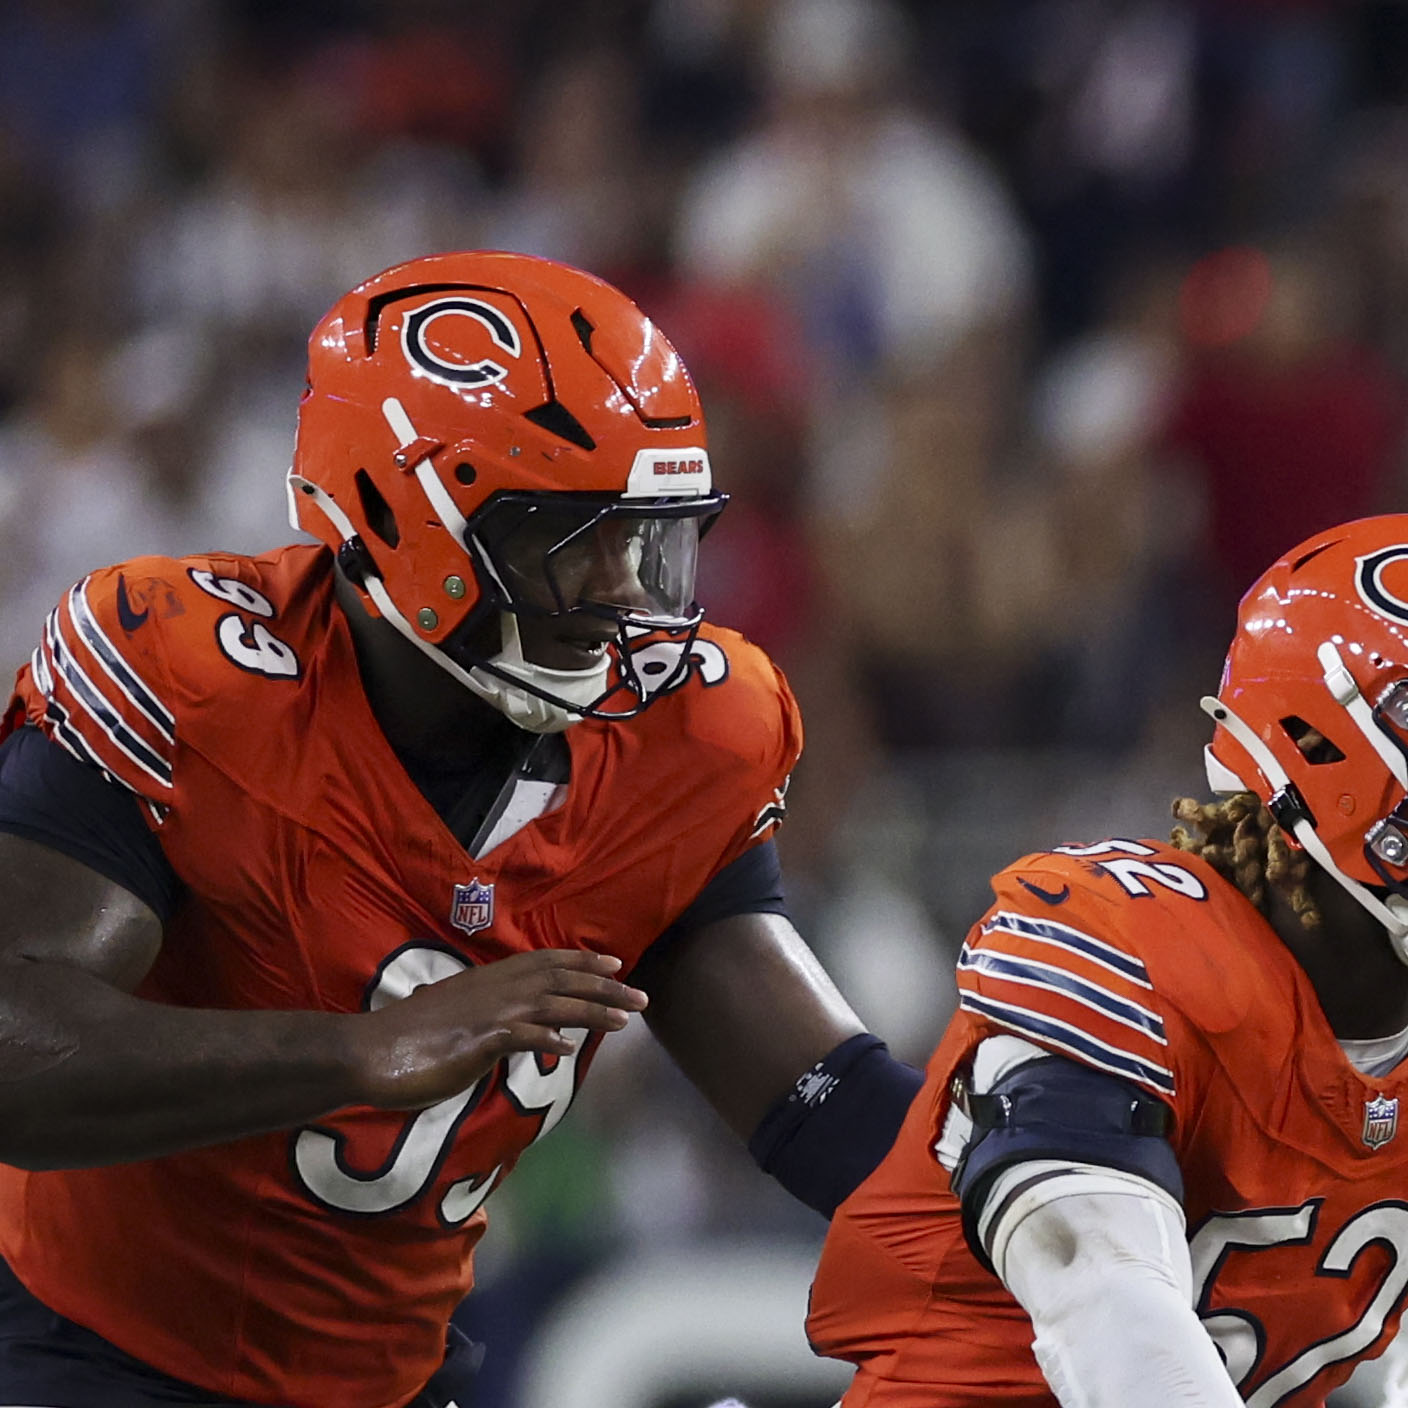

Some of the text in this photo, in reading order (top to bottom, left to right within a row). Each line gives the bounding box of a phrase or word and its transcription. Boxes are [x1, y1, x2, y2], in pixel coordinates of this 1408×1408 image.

[653, 459, 704, 476] BEARS
[188, 566, 303, 680] 99
[457, 905, 487, 924] NFL
